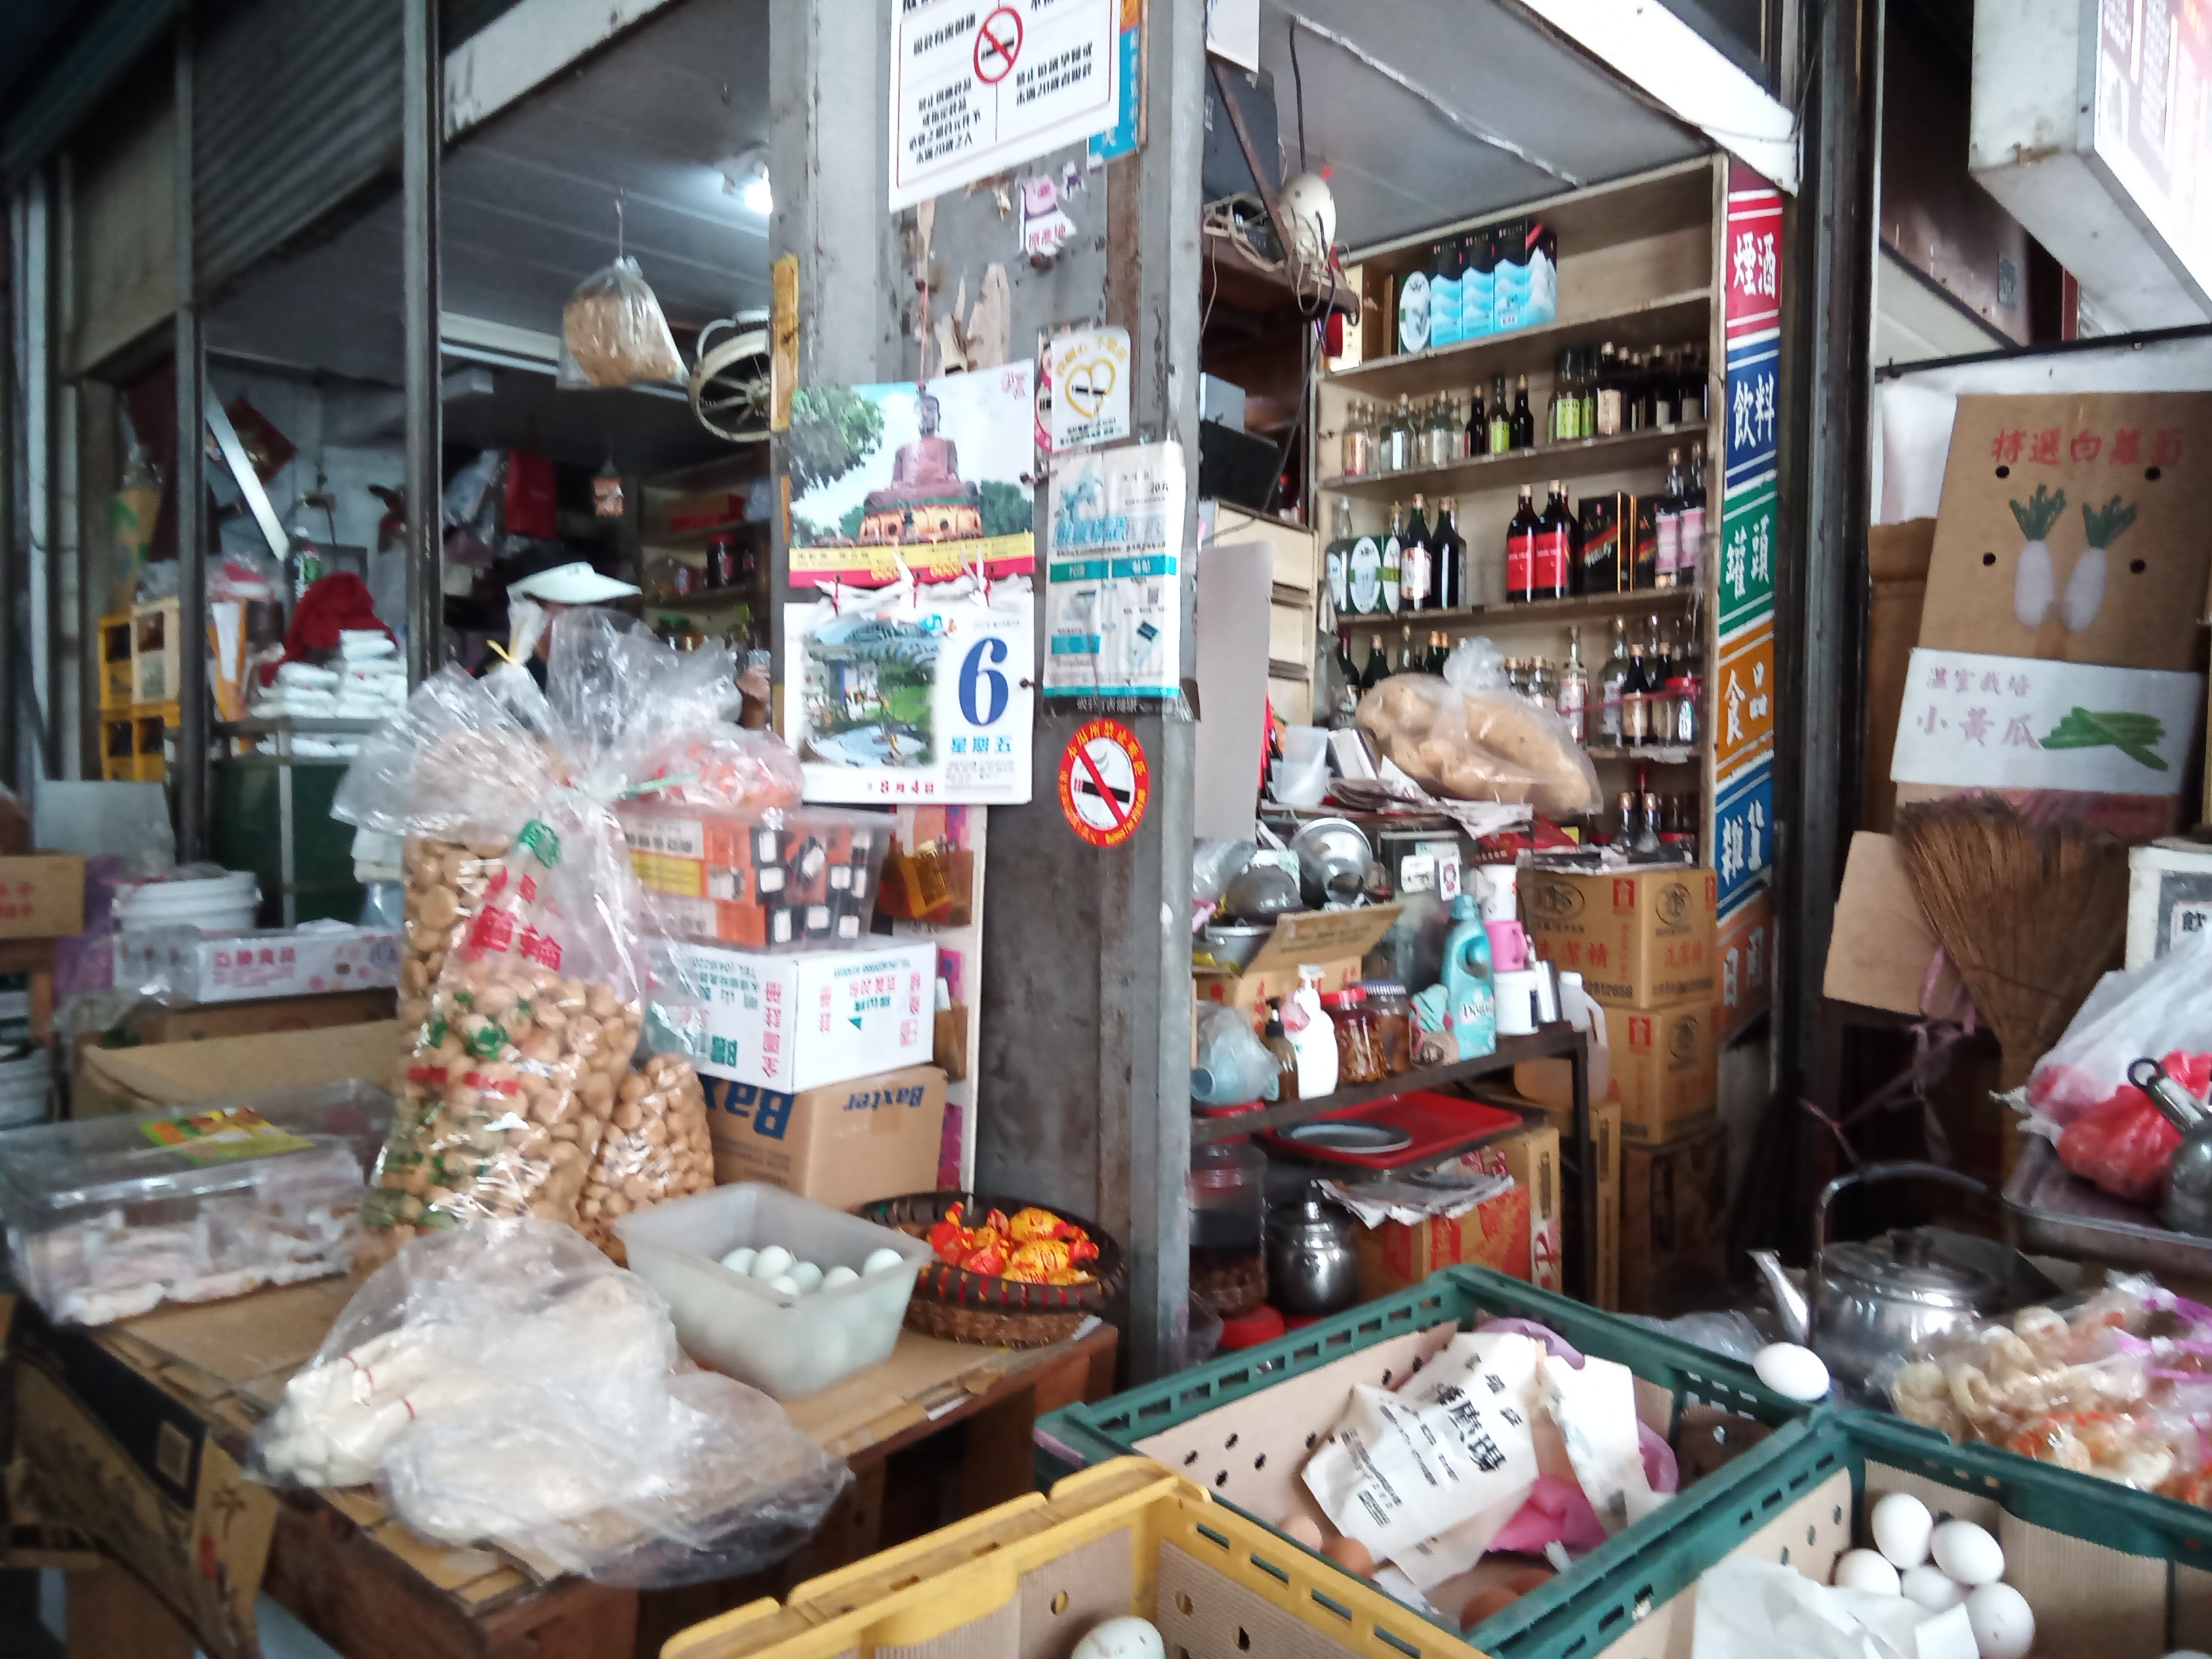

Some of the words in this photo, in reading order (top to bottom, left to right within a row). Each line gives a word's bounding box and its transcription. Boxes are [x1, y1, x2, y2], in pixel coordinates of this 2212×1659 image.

[1732, 230, 1777, 299] 煙酒
[1732, 371, 1776, 451] 飲料
[1725, 514, 1769, 601] 罐頭
[958, 636, 1009, 726] 6
[1723, 661, 1768, 747] 食品
[950, 735, 1012, 755] 星期五
[1916, 705, 2045, 750] 小黃瓜
[1721, 800, 1765, 887] 雜貨
[843, 1085, 925, 1112] Baxter
